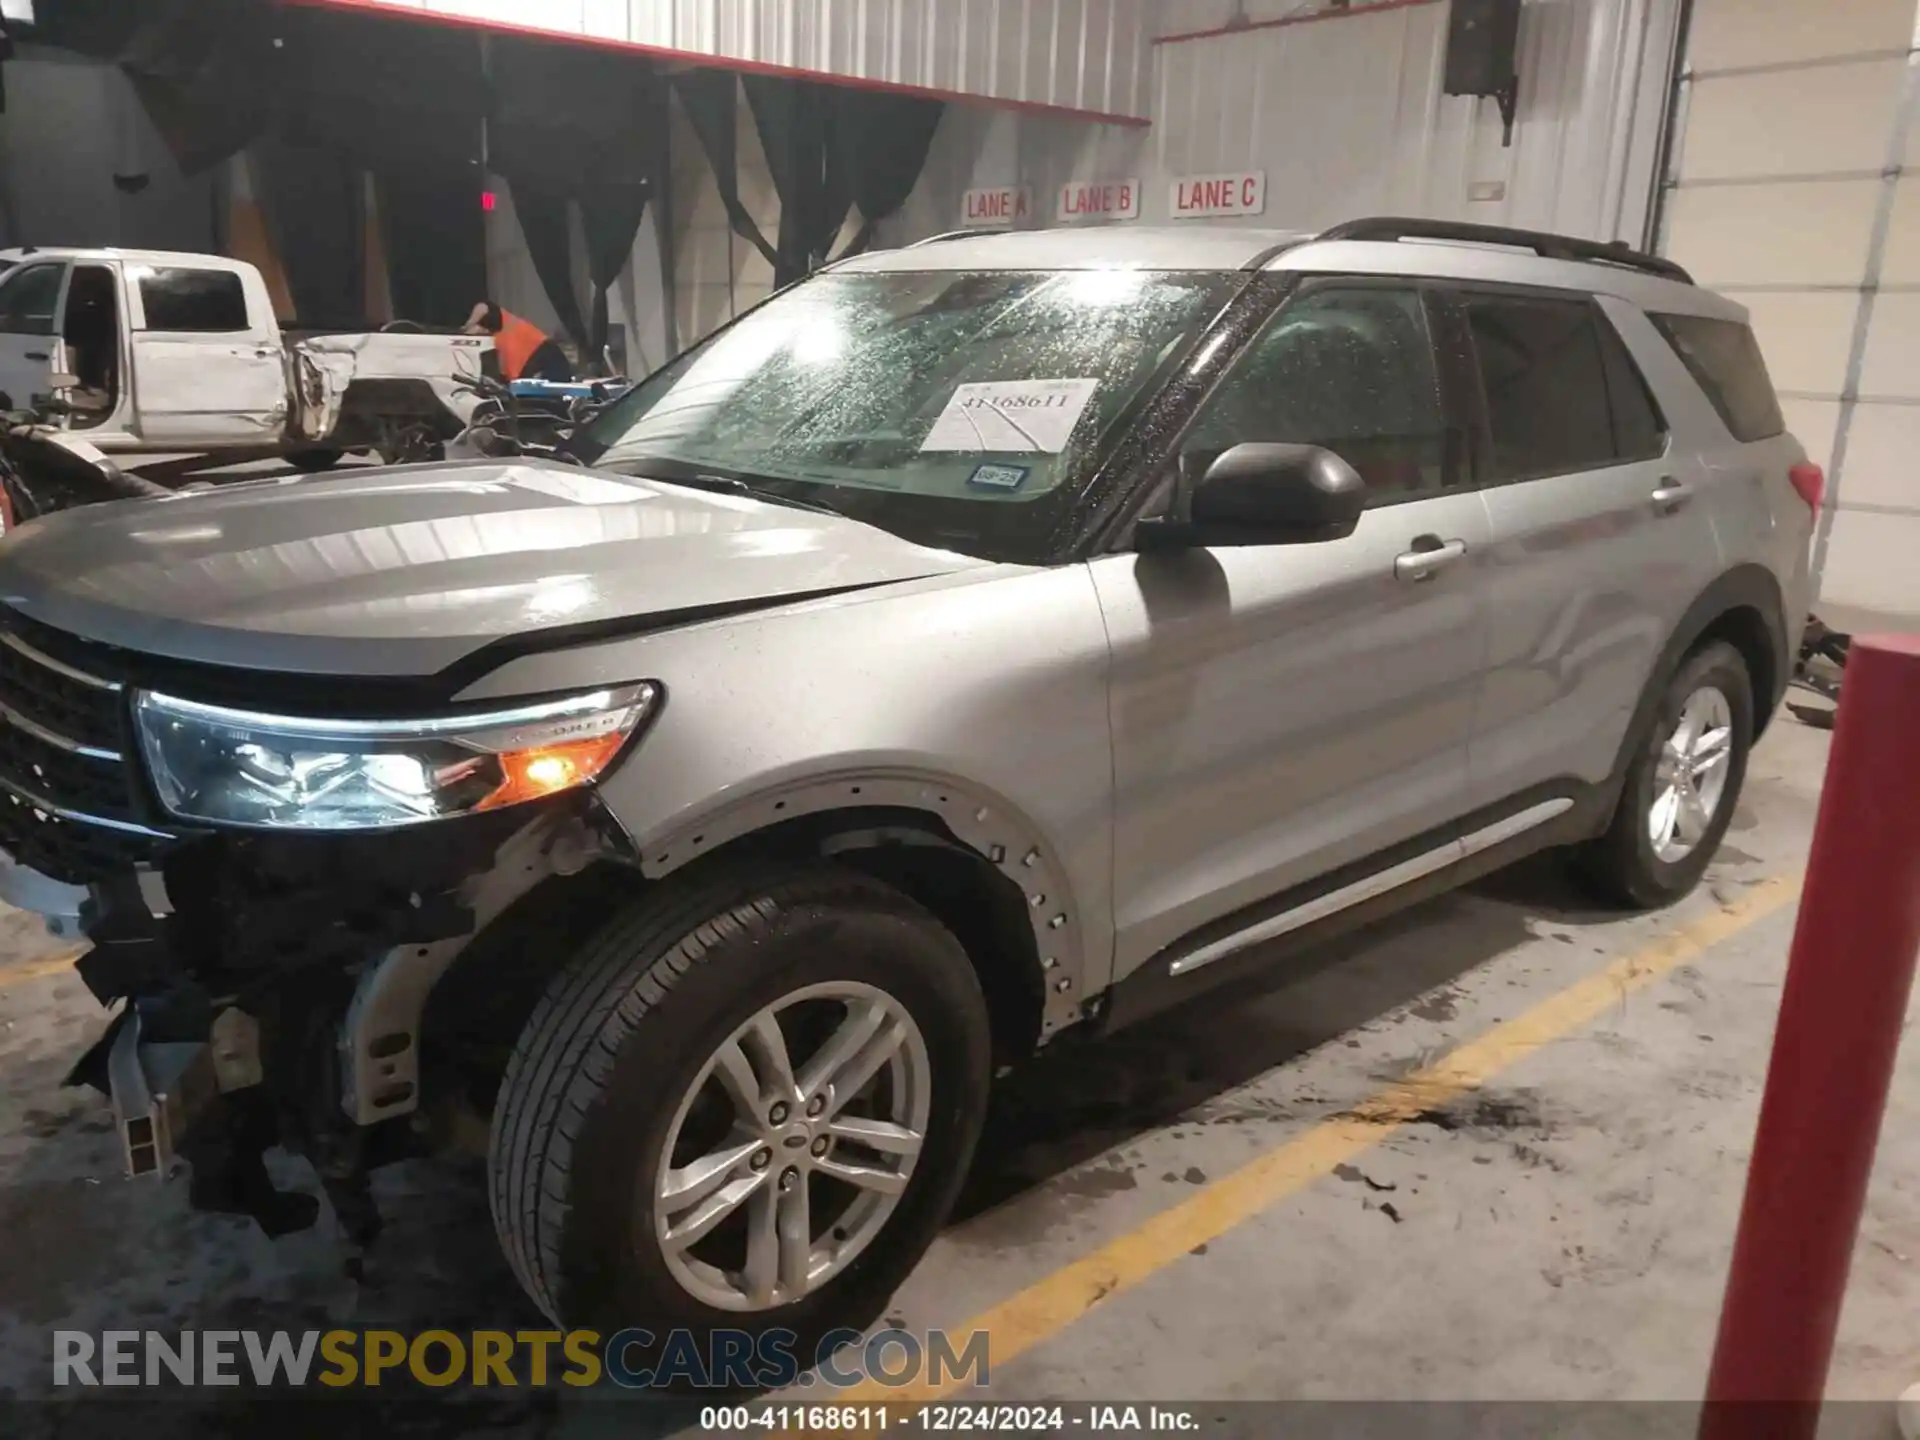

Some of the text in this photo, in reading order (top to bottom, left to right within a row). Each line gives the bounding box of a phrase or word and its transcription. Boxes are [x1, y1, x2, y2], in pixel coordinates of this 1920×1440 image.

[967, 191, 1010, 218] LANE
[1064, 184, 1132, 214] LANE B
[1178, 177, 1256, 210] LANE C
